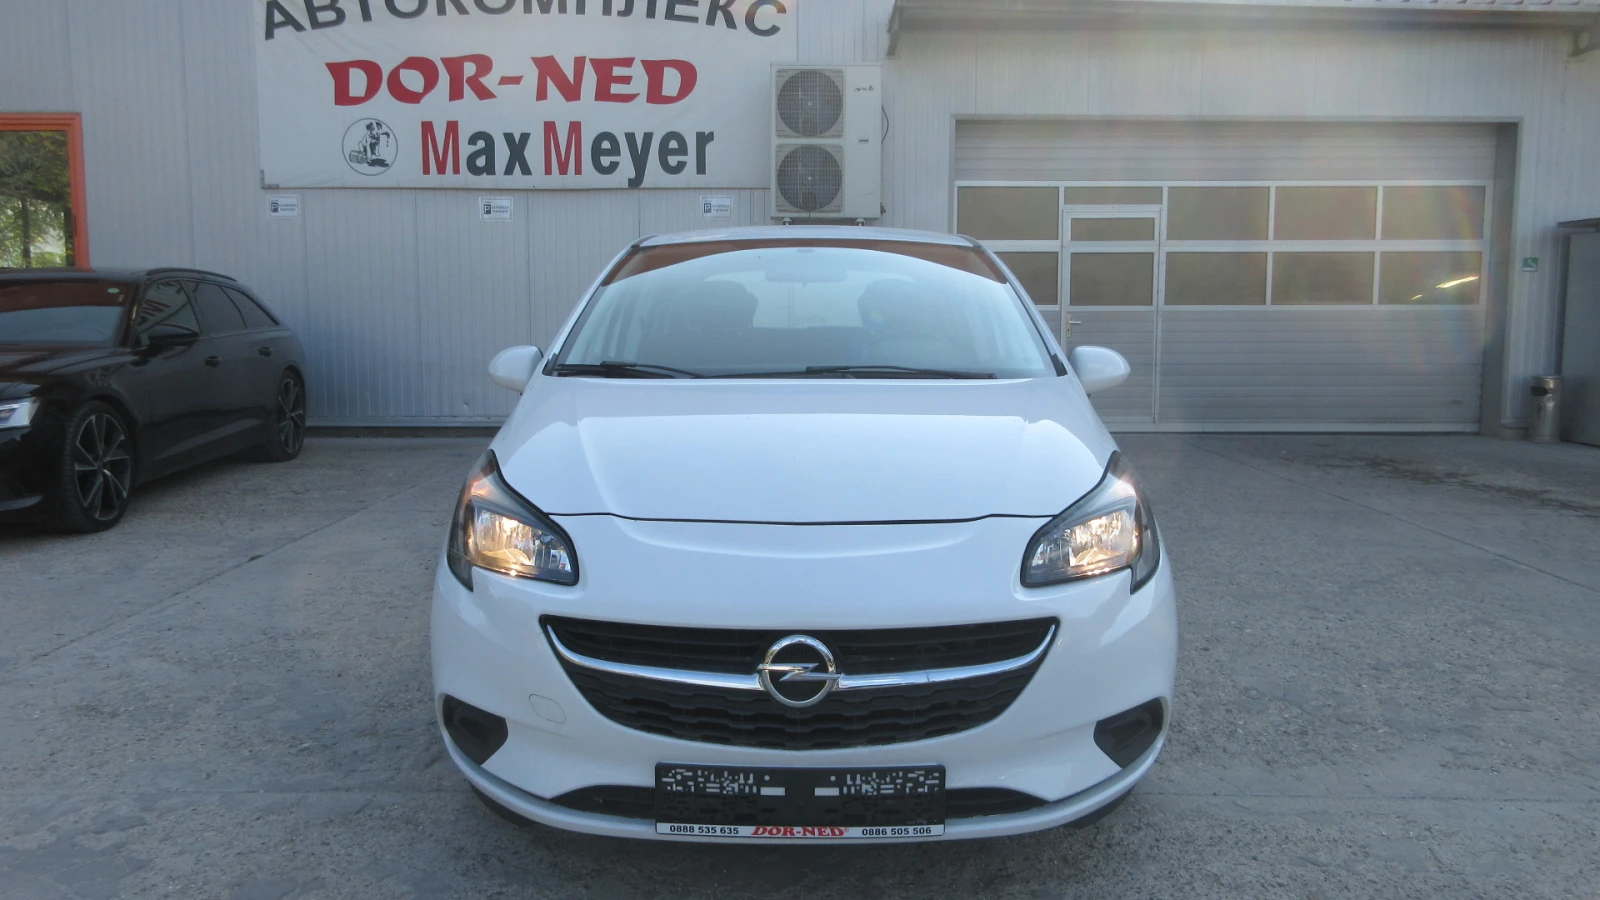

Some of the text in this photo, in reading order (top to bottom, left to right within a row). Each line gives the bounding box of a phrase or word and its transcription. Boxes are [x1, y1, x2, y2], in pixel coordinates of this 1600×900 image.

[325, 54, 699, 106] DOR-NED
[421, 120, 715, 189] MaxMeyer
[669, 824, 739, 835] 0888 535 635
[751, 826, 844, 837] DOR-NED
[861, 826, 932, 836] 0886 505 506
